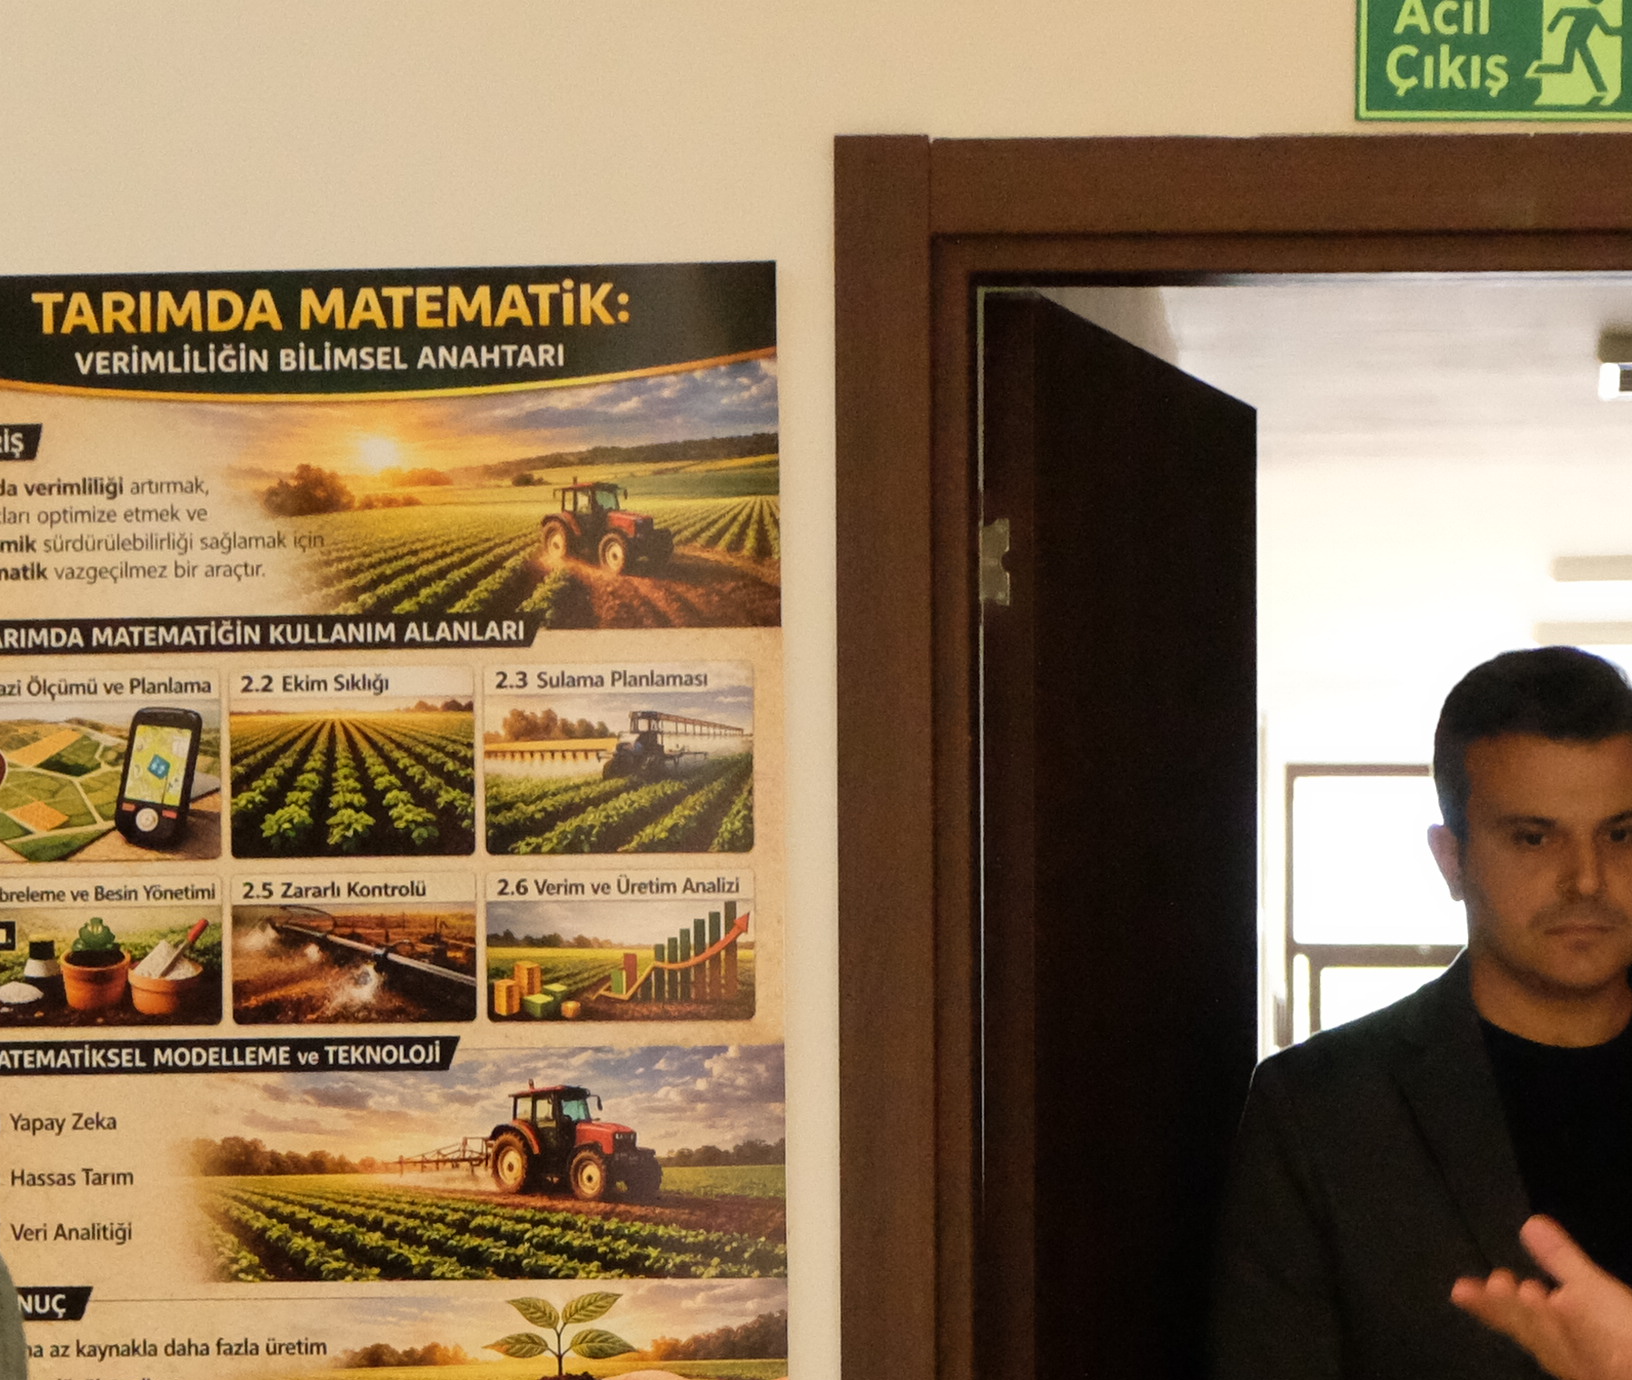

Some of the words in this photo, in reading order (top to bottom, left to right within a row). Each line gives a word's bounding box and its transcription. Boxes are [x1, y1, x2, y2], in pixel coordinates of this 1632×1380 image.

[1386, 44, 1508, 97] Çıkış
[31, 289, 282, 334] TARIMDA
[75, 344, 268, 375] VERİMLİLİĞİN
[280, 342, 408, 371] BİLİMSEL
[417, 344, 564, 369] ANAHTARI
[24, 477, 123, 500] verimliliği
[131, 477, 208, 495] artırmak,
[43, 532, 193, 555] sürdürülebilirliği
[200, 531, 286, 554] sağlamak
[294, 531, 325, 553] için
[92, 621, 260, 646] MATEMATİĞİN
[270, 622, 395, 644] KULLANIM
[404, 620, 524, 641] ALANLARI
[27, 677, 97, 701] Ölçümü
[103, 683, 124, 695] ve
[129, 677, 211, 694] Planlama
[241, 675, 273, 693] 2.2
[282, 675, 328, 692] Ekim
[334, 674, 389, 696] Sıklığı
[496, 671, 528, 689] 2.3
[537, 671, 604, 689] Sulama
[611, 670, 707, 687] Planlaması
[243, 882, 273, 899] 2.5
[281, 881, 340, 898] Zararlı
[347, 881, 426, 897] Kontrolü
[497, 878, 528, 896] 2.6
[534, 879, 585, 896] Verim
[591, 883, 611, 895] ve
[617, 875, 677, 895] Üretim
[682, 877, 739, 894] Analizi
[154, 1046, 290, 1066] MODELLEME
[297, 1052, 319, 1065] ve
[324, 1040, 440, 1064] TEKNOLOJİ
[10, 1113, 66, 1136] Yapay
[72, 1112, 117, 1130] Zeka
[11, 1169, 76, 1187] Hassas
[81, 1168, 134, 1186] Tarım
[10, 1223, 47, 1241] Veri
[53, 1222, 132, 1245] Analitiği
[50, 1345, 70, 1358] az
[76, 1339, 158, 1362] kaynakla
[164, 1338, 210, 1357] daha
[216, 1337, 259, 1356] fazla
[266, 1337, 327, 1356] üretim
